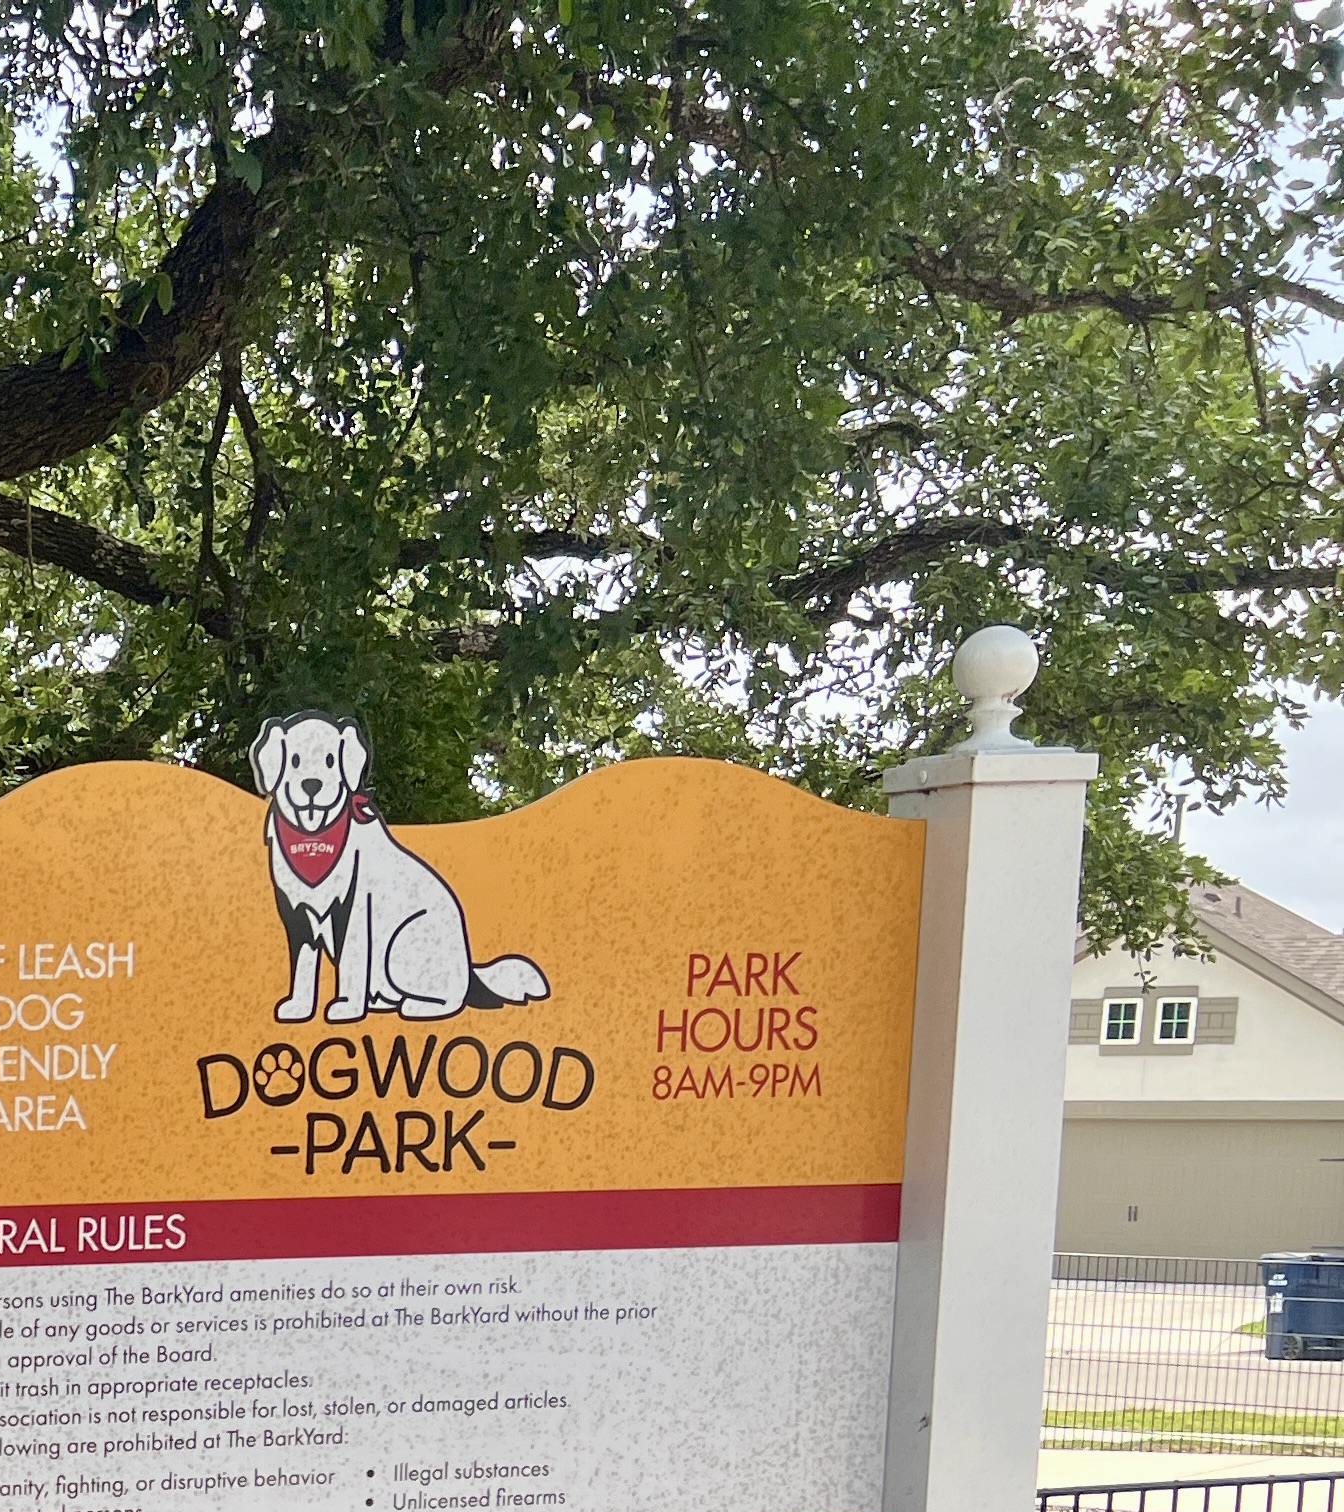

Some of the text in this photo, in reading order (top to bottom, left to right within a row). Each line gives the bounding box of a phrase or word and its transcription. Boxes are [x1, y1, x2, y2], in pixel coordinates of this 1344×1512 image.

[290, 842, 335, 856] BRYSON
[19, 942, 134, 980] LEASH
[687, 951, 802, 998] PARK
[656, 1005, 818, 1053] HOURS
[652, 1062, 822, 1101] 8AM-9PM
[78, 1213, 186, 1252] RULES
[49, 1290, 97, 1312] using
[103, 1285, 135, 1306] The
[141, 1282, 223, 1305] BarkYard
[229, 1283, 315, 1302] amenities
[320, 1279, 345, 1299] do
[350, 1285, 372, 1298] so
[376, 1281, 395, 1298] at
[399, 1277, 439, 1297] their
[443, 1282, 482, 1296] own
[15, 1376, 59, 1397] trash
[65, 1378, 81, 1395] in
[87, 1374, 198, 1400] appropriate
[203, 1368, 312, 1395] receptacles.
[88, 1407, 101, 1424] is
[107, 1406, 136, 1423] not
[141, 1399, 246, 1427] responsible
[251, 1398, 277, 1418] for
[282, 1397, 317, 1419] lost,
[322, 1395, 380, 1417] stolen,
[386, 1400, 406, 1414] or
[410, 1390, 499, 1416] damaged
[66, 1440, 97, 1454] are
[103, 1430, 197, 1458] prohibited
[202, 1433, 221, 1449] at
[225, 1428, 256, 1448] The
[54, 1473, 129, 1499] fighting,
[135, 1478, 155, 1492] or
[160, 1471, 248, 1494] disruptive
[253, 1466, 335, 1487] behavior
[393, 1459, 549, 1486] Illegal substances
[392, 1486, 566, 1511] Unlicensed firearms
